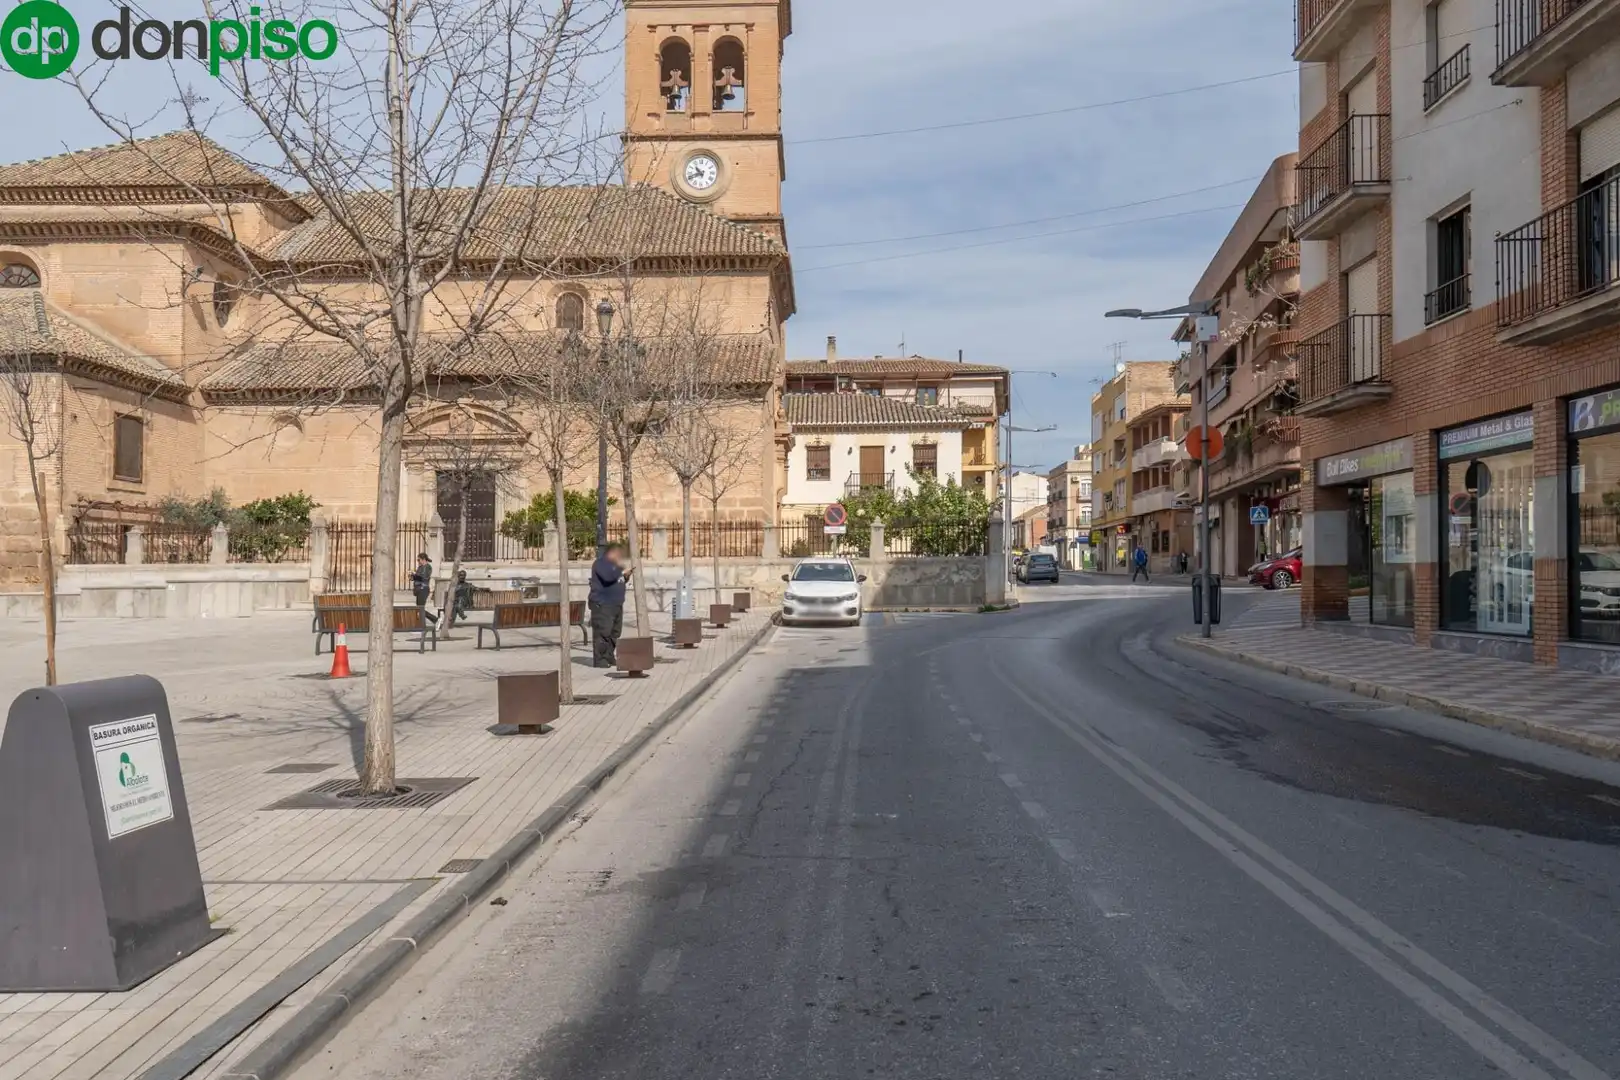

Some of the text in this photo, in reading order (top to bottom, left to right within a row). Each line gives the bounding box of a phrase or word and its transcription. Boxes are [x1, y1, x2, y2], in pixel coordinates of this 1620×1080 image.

[1442, 427, 1478, 445] PREMIUM
[1480, 421, 1503, 437] Metal
[93, 722, 155, 740] BASURA ORGANICA
